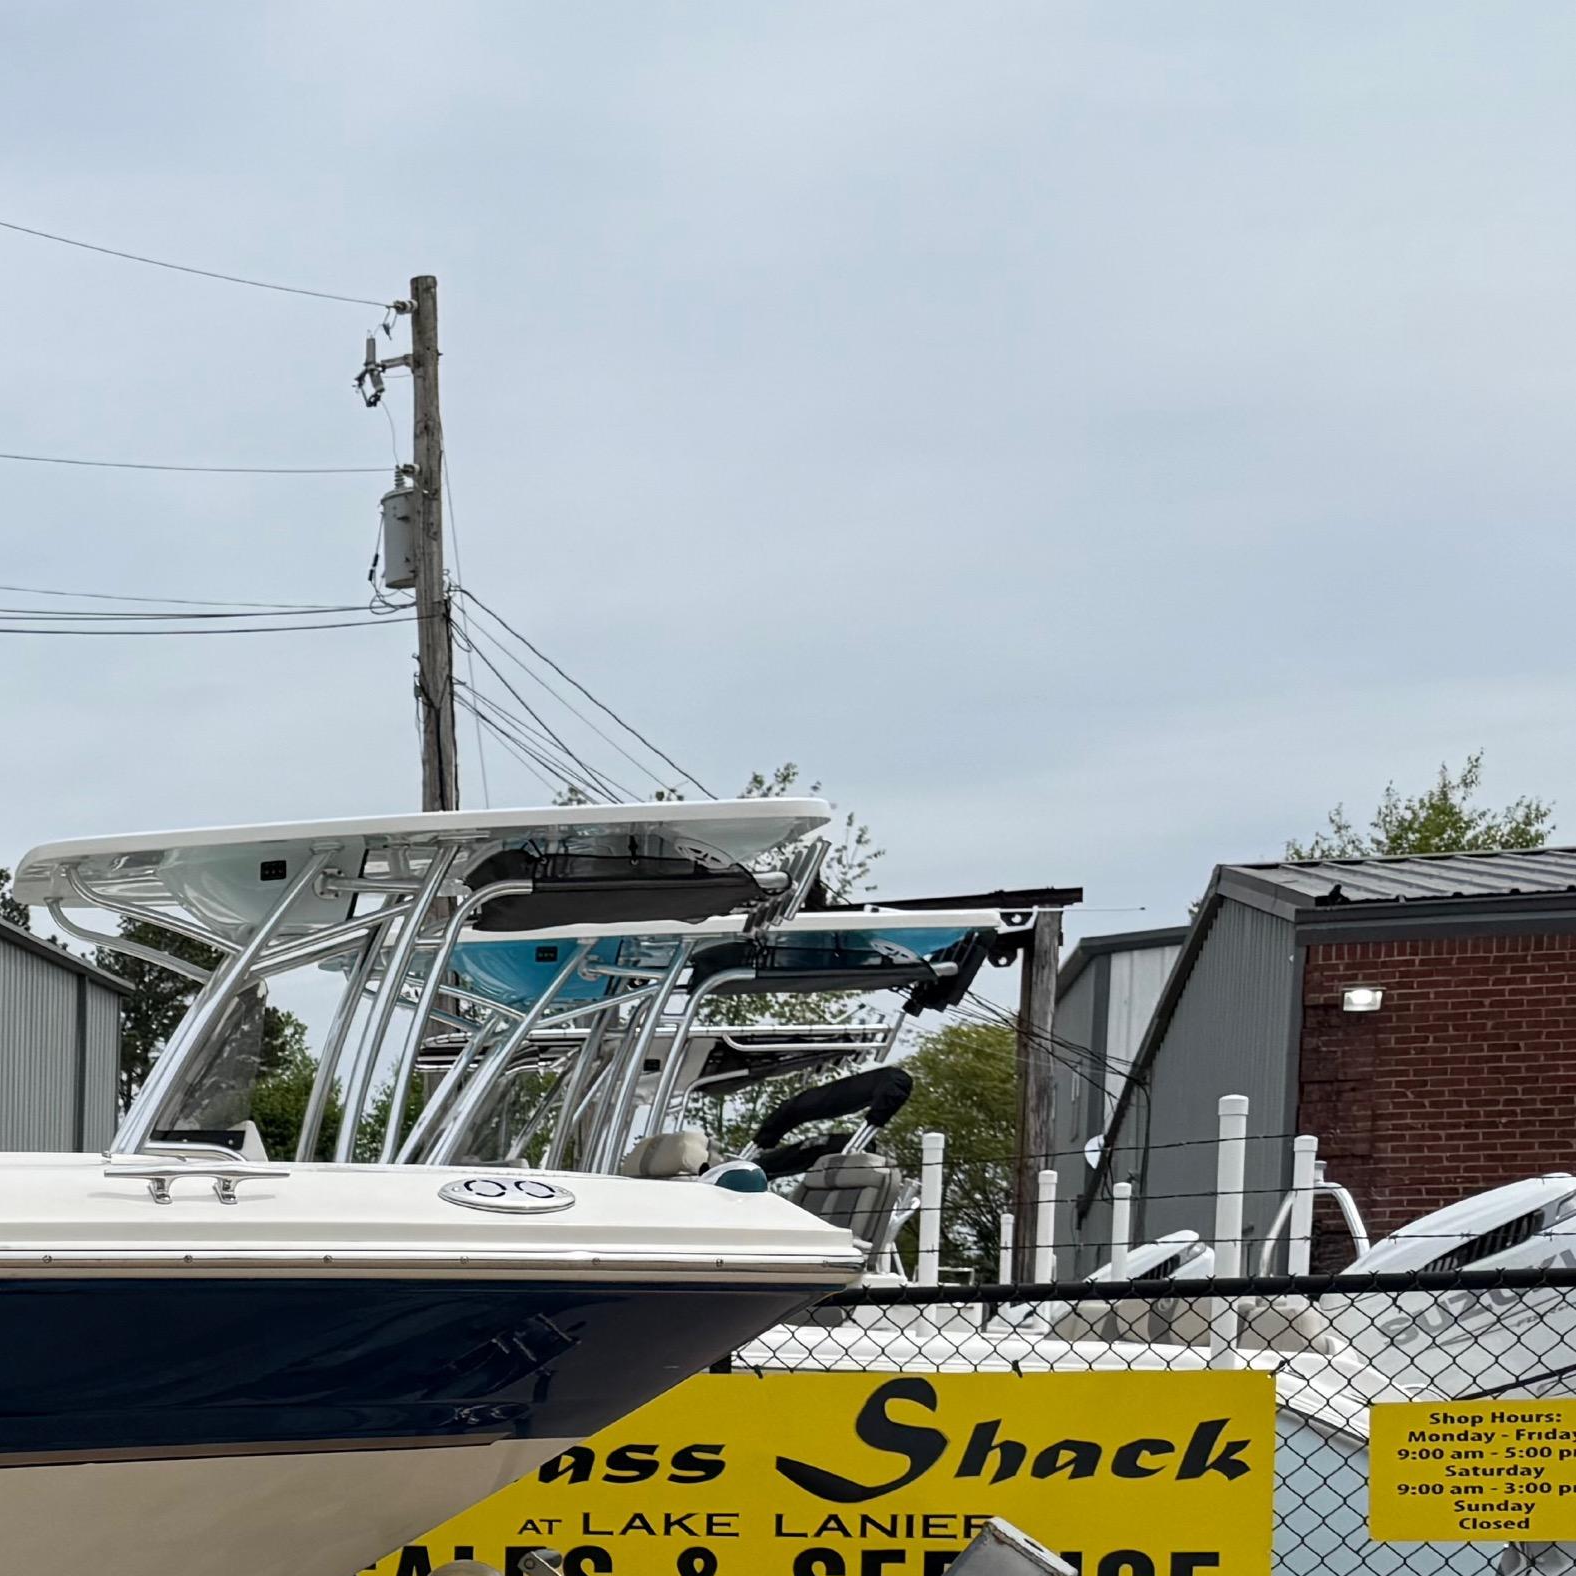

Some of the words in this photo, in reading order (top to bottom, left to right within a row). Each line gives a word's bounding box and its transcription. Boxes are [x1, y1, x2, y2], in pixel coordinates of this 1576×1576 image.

[1429, 1412, 1484, 1427] Shop
[1490, 1411, 1562, 1423] Hours:
[538, 1443, 727, 1485] ass
[775, 1376, 1251, 1504] Shack
[1408, 1430, 1496, 1444] Monday
[1397, 1448, 1445, 1460] 9:00
[1450, 1450, 1485, 1460] am
[1504, 1446, 1553, 1459] 5:00
[1445, 1464, 1545, 1479] Saturday
[1397, 1484, 1445, 1495] 9:00
[1449, 1486, 1484, 1495] am
[1504, 1482, 1552, 1494] 3:00
[1454, 1500, 1536, 1514] Sunday
[517, 1519, 563, 1535] AT
[581, 1512, 740, 1538] LAKE
[1458, 1517, 1530, 1530] Closed
